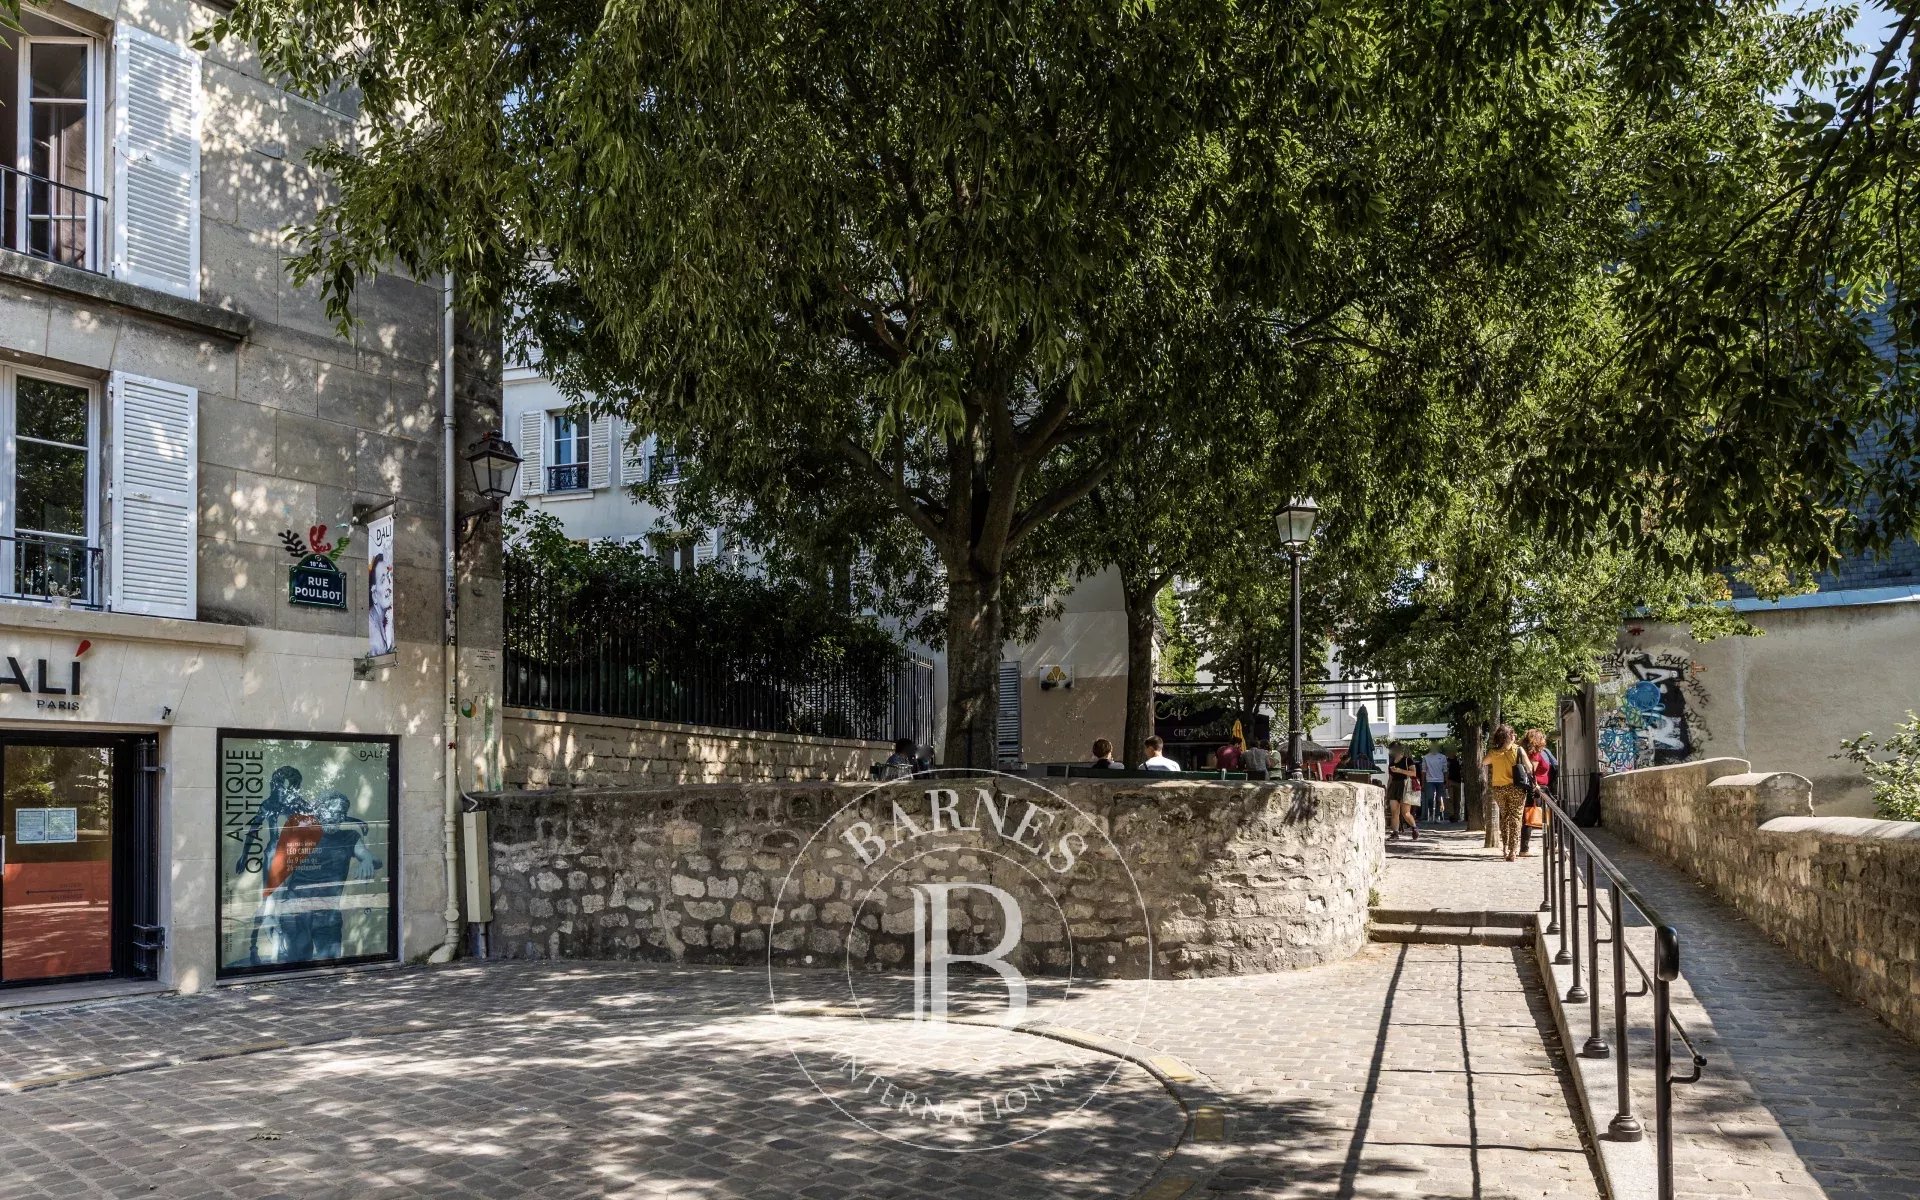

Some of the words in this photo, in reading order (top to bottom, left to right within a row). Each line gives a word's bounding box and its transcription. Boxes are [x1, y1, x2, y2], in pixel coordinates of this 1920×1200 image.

[308, 576, 329, 587] RUE
[295, 586, 341, 600] POULBOT
[36, 700, 79, 710] PARIS
[226, 750, 243, 842] ANTIQUE
[246, 750, 263, 873] QUANTIQUE
